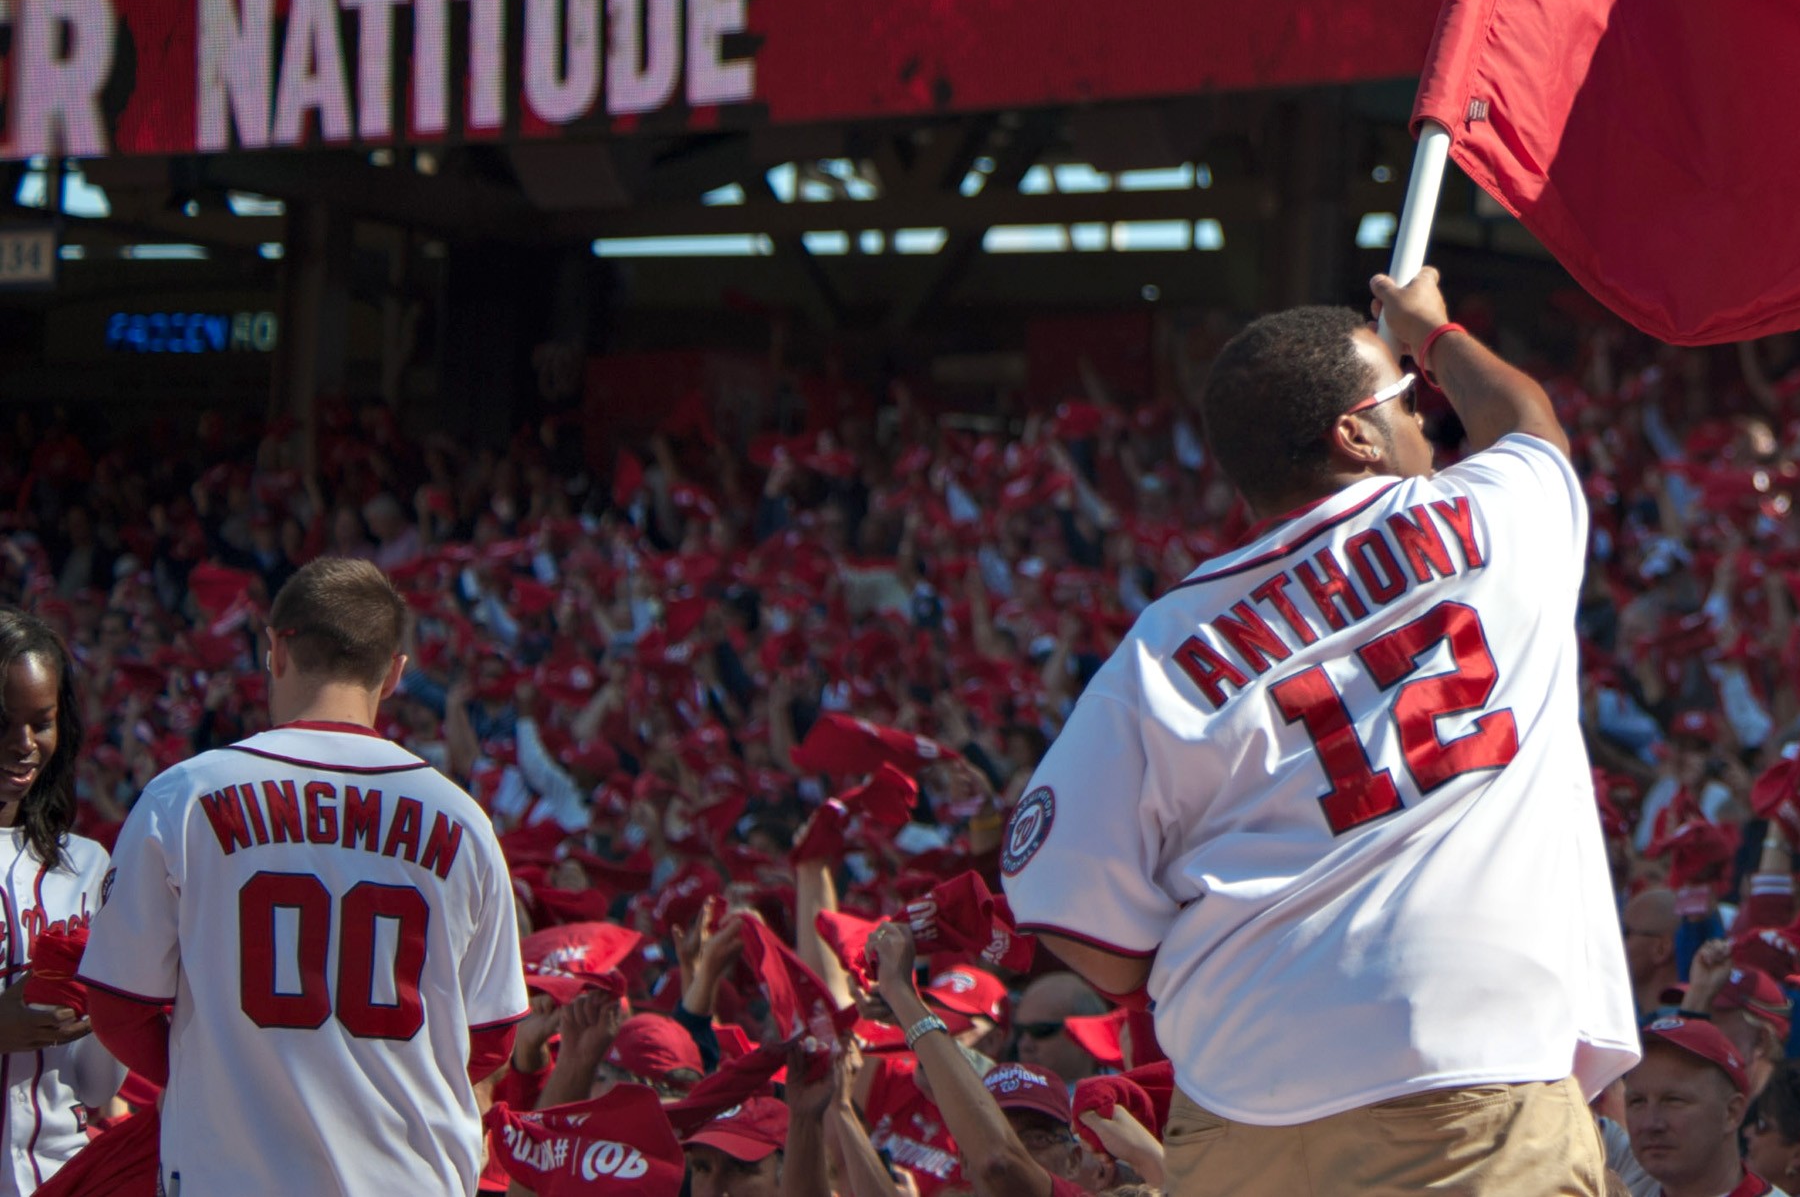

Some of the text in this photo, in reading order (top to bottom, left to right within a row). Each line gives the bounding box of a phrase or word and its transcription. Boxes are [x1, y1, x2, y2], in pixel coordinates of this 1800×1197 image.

[0, 238, 43, 274] 34
[1172, 496, 1487, 709] ANTHONY
[1270, 601, 1519, 836] 12
[199, 780, 463, 881] WINGMAN
[239, 871, 430, 1041] 00
